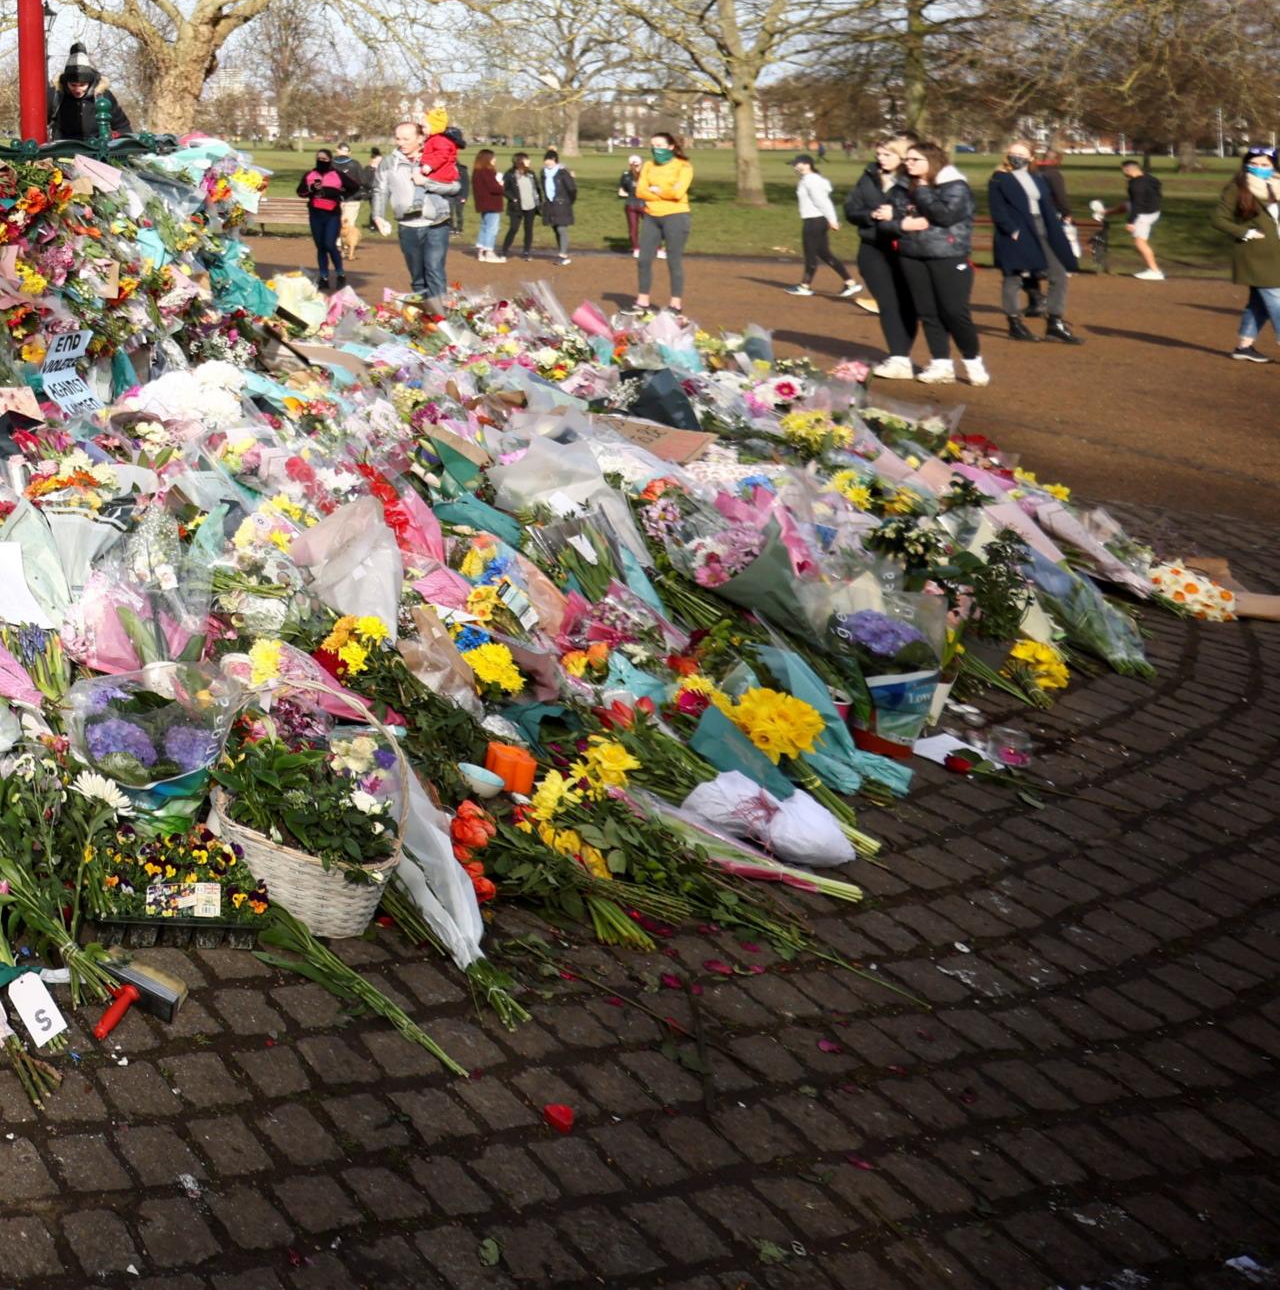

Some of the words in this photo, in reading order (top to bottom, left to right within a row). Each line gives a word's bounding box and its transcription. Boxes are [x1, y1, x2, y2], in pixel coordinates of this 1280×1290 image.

[55, 333, 81, 353] END
[49, 379, 88, 400] AGAINST
[35, 1009, 52, 1031] S
